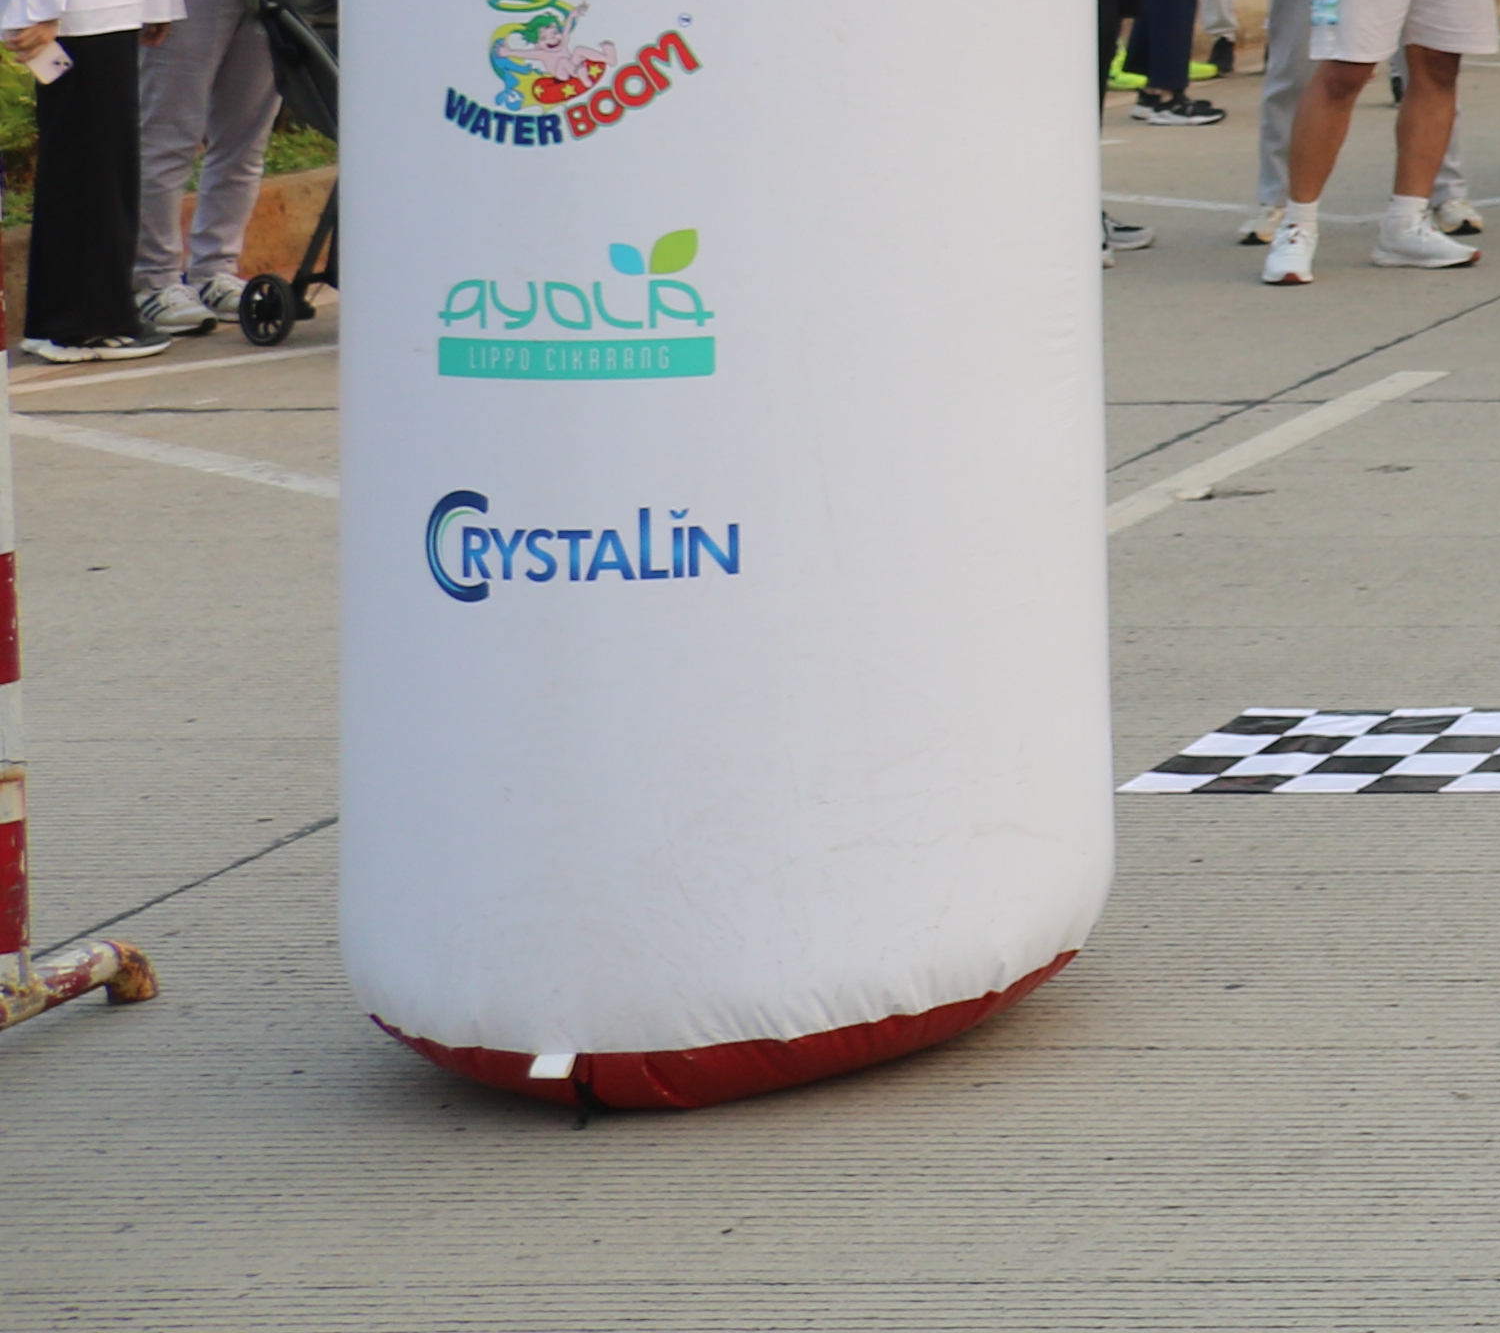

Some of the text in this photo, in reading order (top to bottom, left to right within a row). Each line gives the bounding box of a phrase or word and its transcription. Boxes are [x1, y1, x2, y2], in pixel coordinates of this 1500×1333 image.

[444, 29, 703, 147] WATER BOOM
[437, 279, 715, 330] AYOLA
[468, 344, 671, 371] LIPPO CIKARANG
